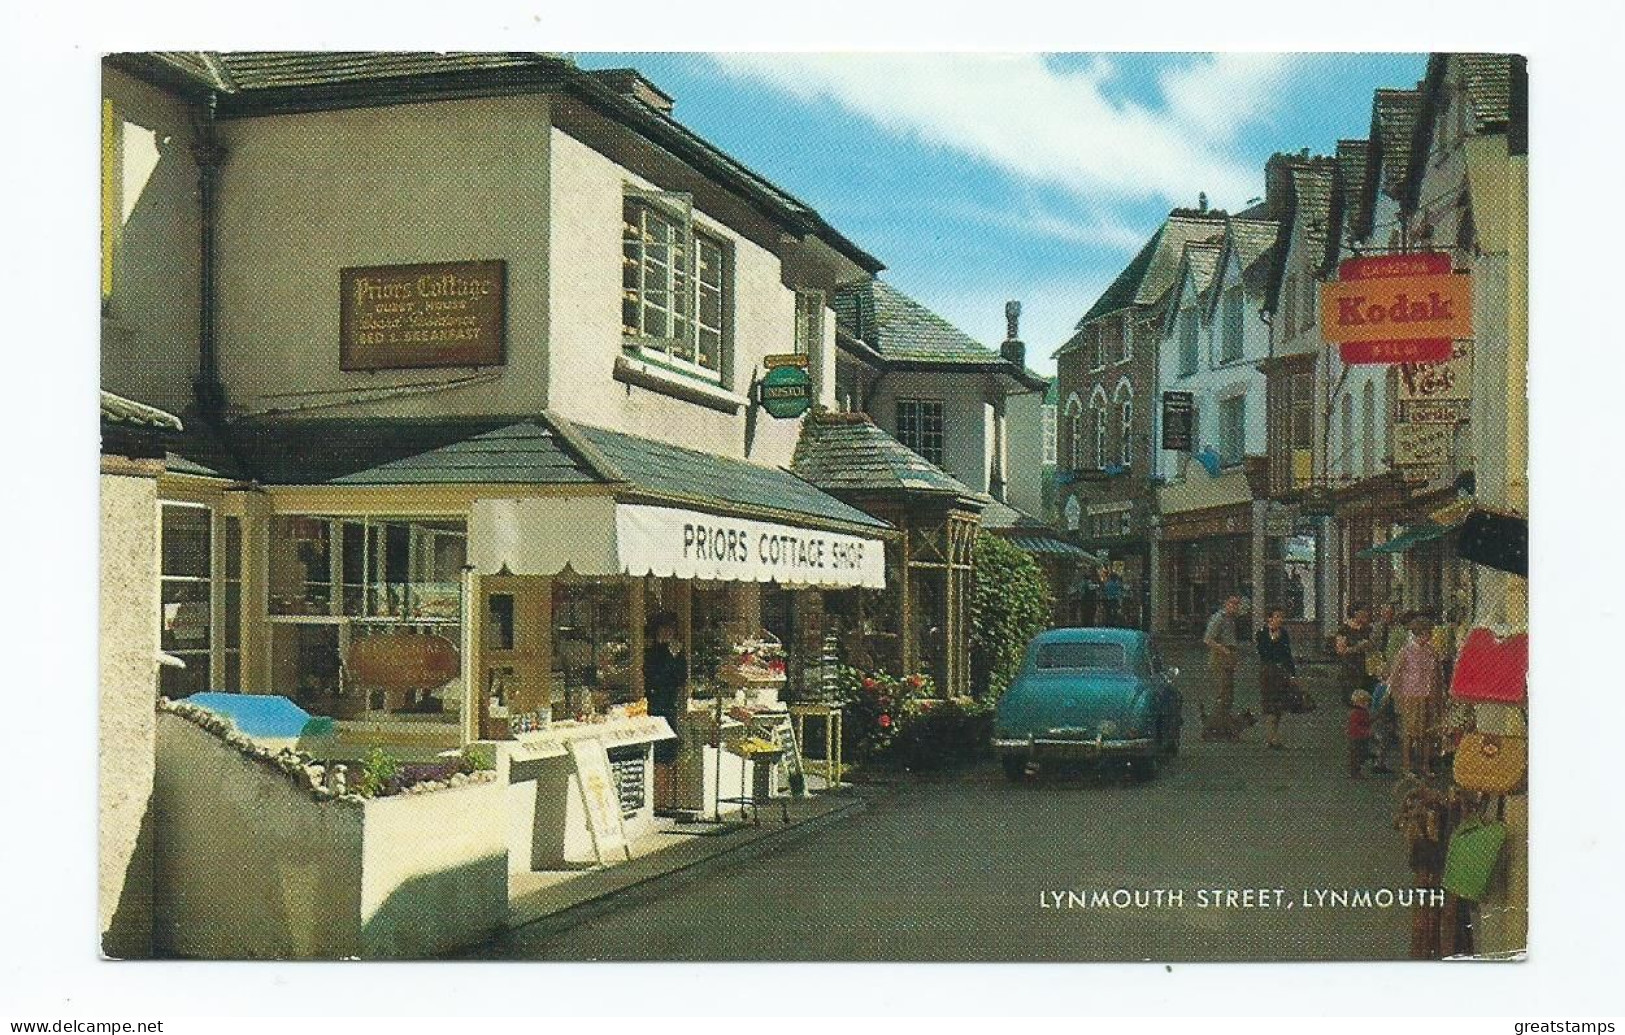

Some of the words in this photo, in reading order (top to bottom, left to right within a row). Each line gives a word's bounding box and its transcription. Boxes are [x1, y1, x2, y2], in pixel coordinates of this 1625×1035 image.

[354, 277, 412, 305] Priors
[417, 274, 491, 301] Cottage
[425, 299, 467, 311] HOUSE
[1338, 292, 1454, 325] Kodak
[358, 332, 385, 344] BED
[404, 327, 481, 342] BREAKFAST
[683, 524, 748, 562] PRIORS
[759, 533, 824, 568] COTTAGE
[833, 542, 865, 570] SHOP
